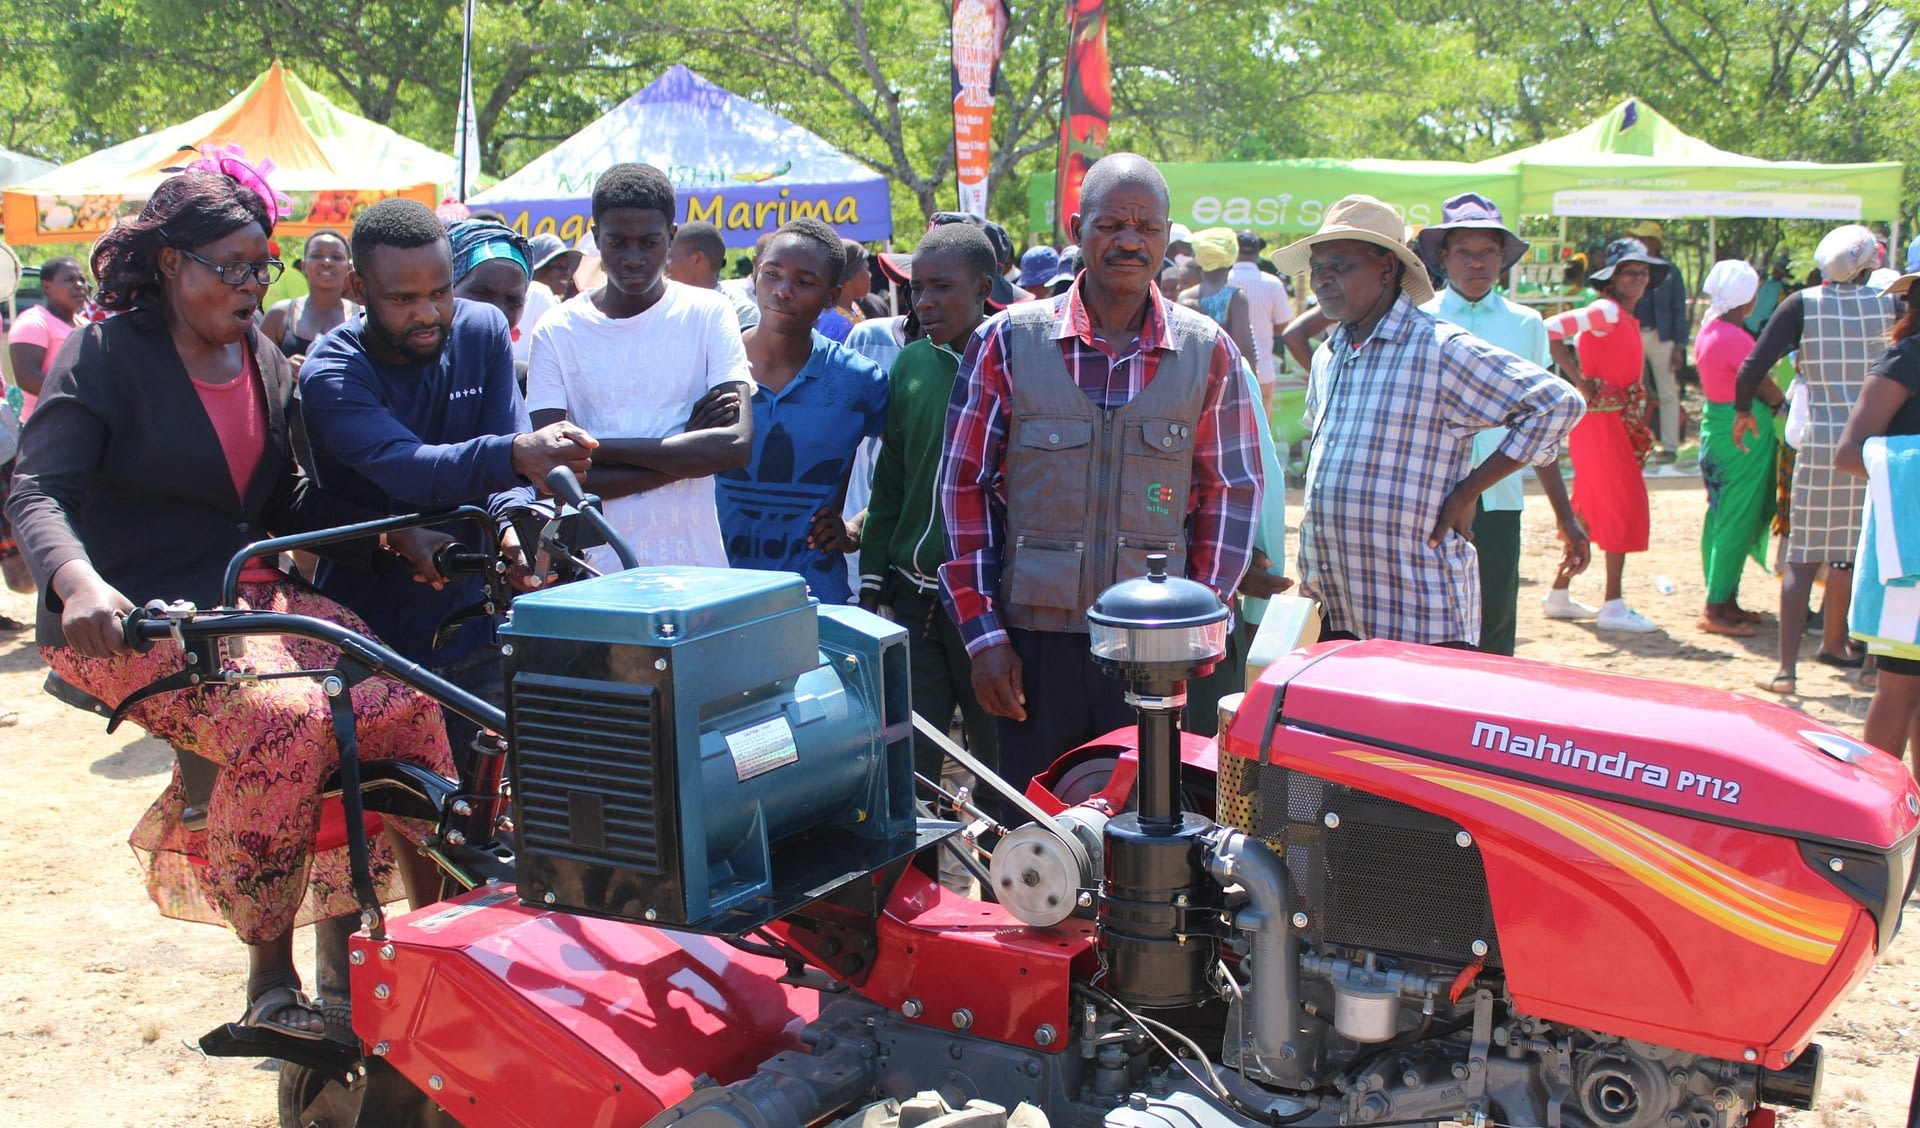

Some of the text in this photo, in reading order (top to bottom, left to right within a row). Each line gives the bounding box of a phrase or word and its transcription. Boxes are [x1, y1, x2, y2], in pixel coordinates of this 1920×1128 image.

[687, 187, 859, 230] Marima
[1191, 192, 1293, 226] easi
[1470, 719, 1742, 804] Mahindra PT12
